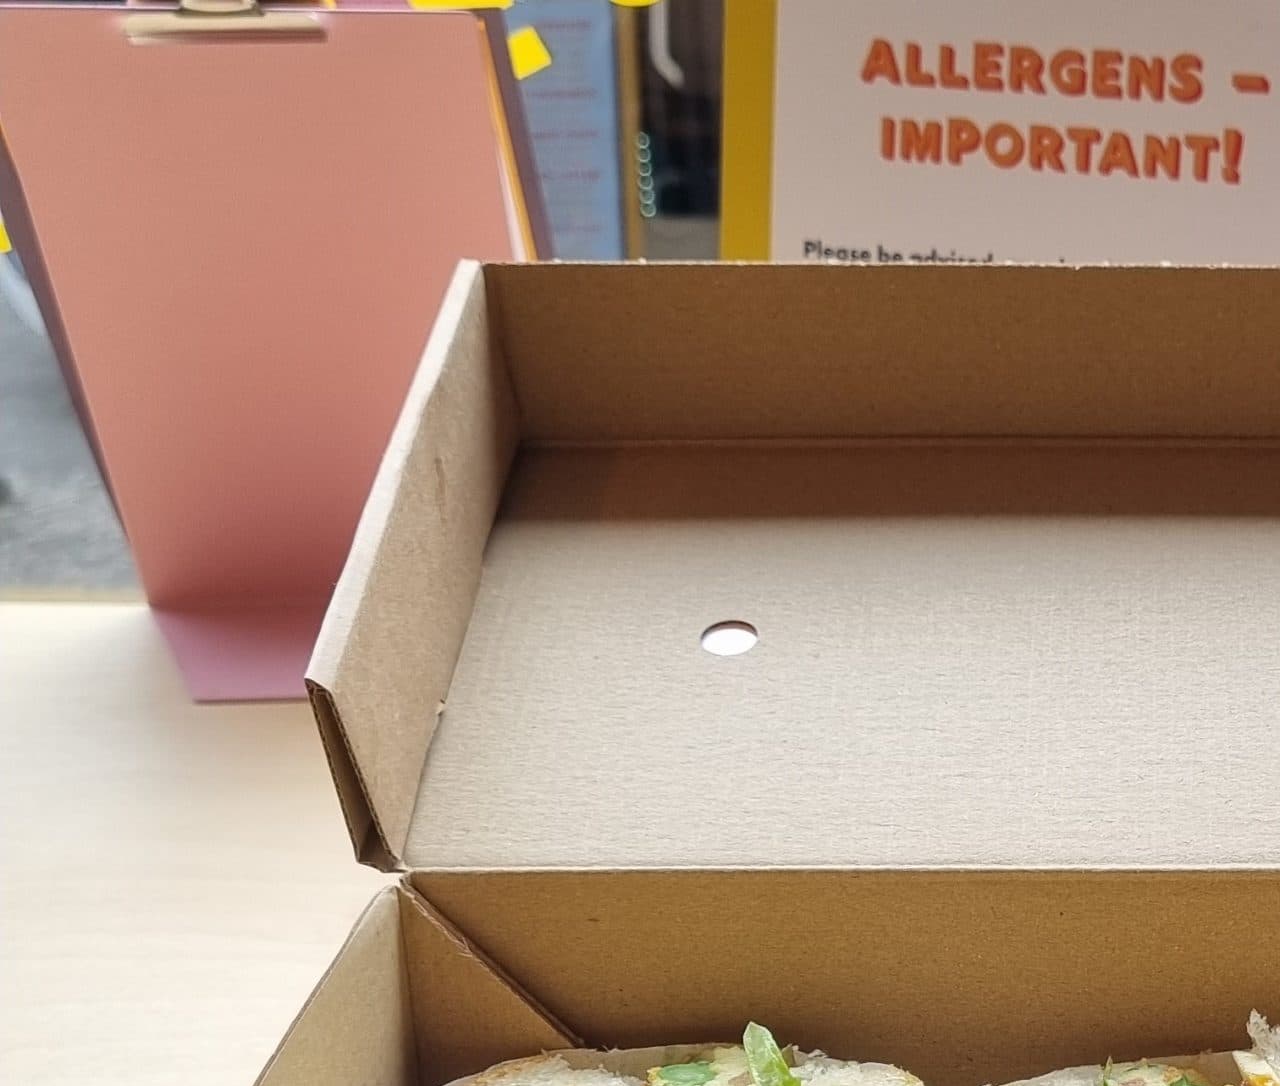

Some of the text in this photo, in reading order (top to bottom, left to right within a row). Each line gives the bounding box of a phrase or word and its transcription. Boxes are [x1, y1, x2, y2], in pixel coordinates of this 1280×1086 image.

[860, 37, 1204, 104] ALLERGENS
[880, 116, 1244, 185] IMPORTANT!
[803, 240, 872, 262] Please
[878, 245, 902, 264] be
